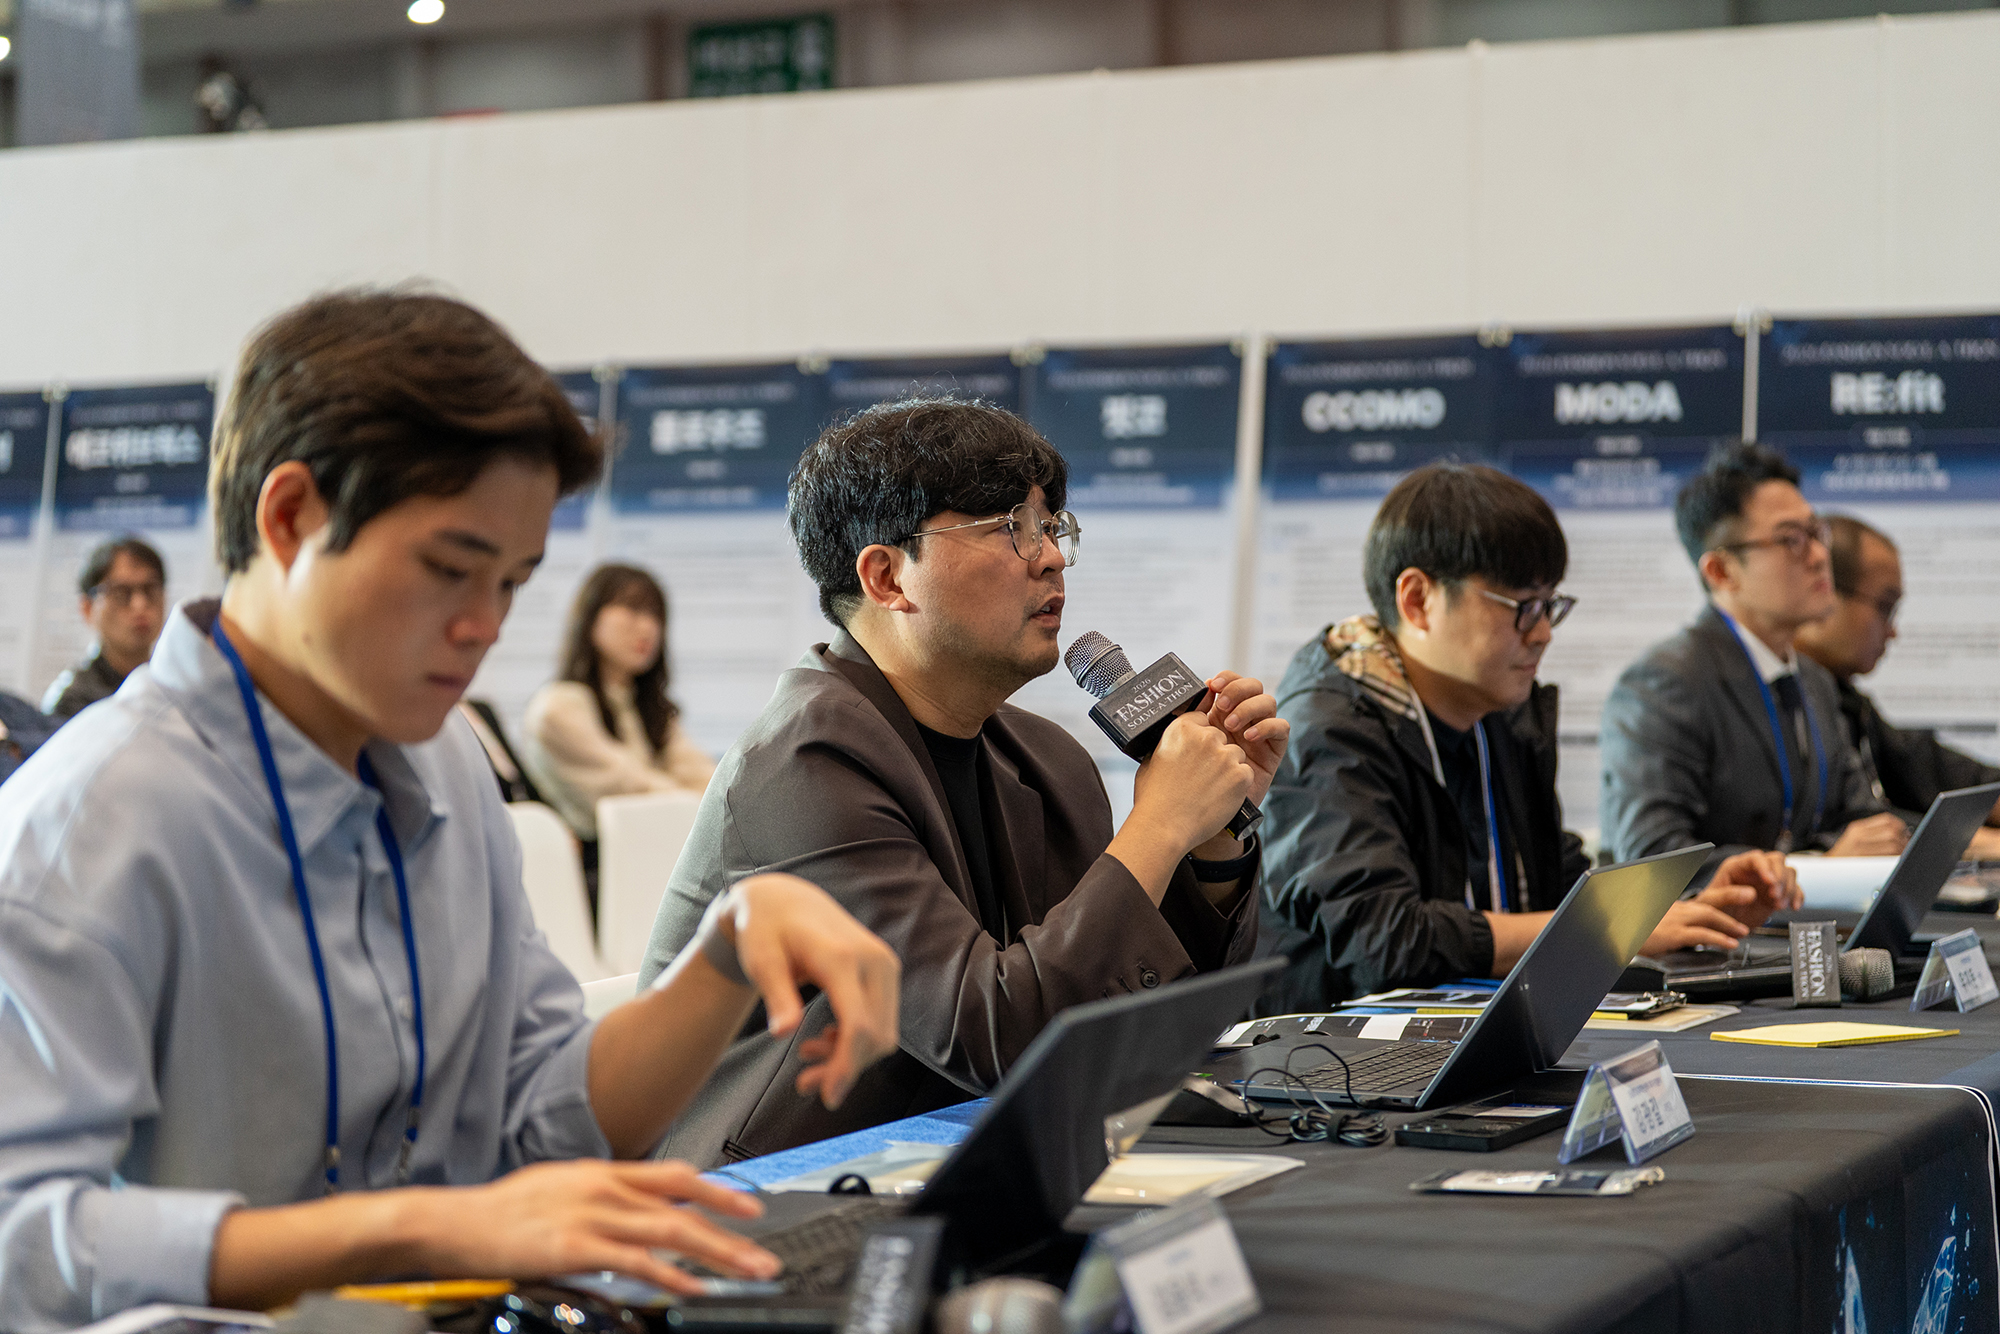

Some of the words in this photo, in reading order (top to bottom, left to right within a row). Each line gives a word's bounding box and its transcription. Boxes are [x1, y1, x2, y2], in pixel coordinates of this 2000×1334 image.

[1554, 380, 1683, 424] MODA
[1831, 369, 1946, 415] RE:fit
[1116, 669, 1187, 722] FASHION
[1127, 682, 1194, 730] SOLVE-A-THON
[1131, 678, 1152, 694] 2026
[1807, 931, 1826, 997] FASHION
